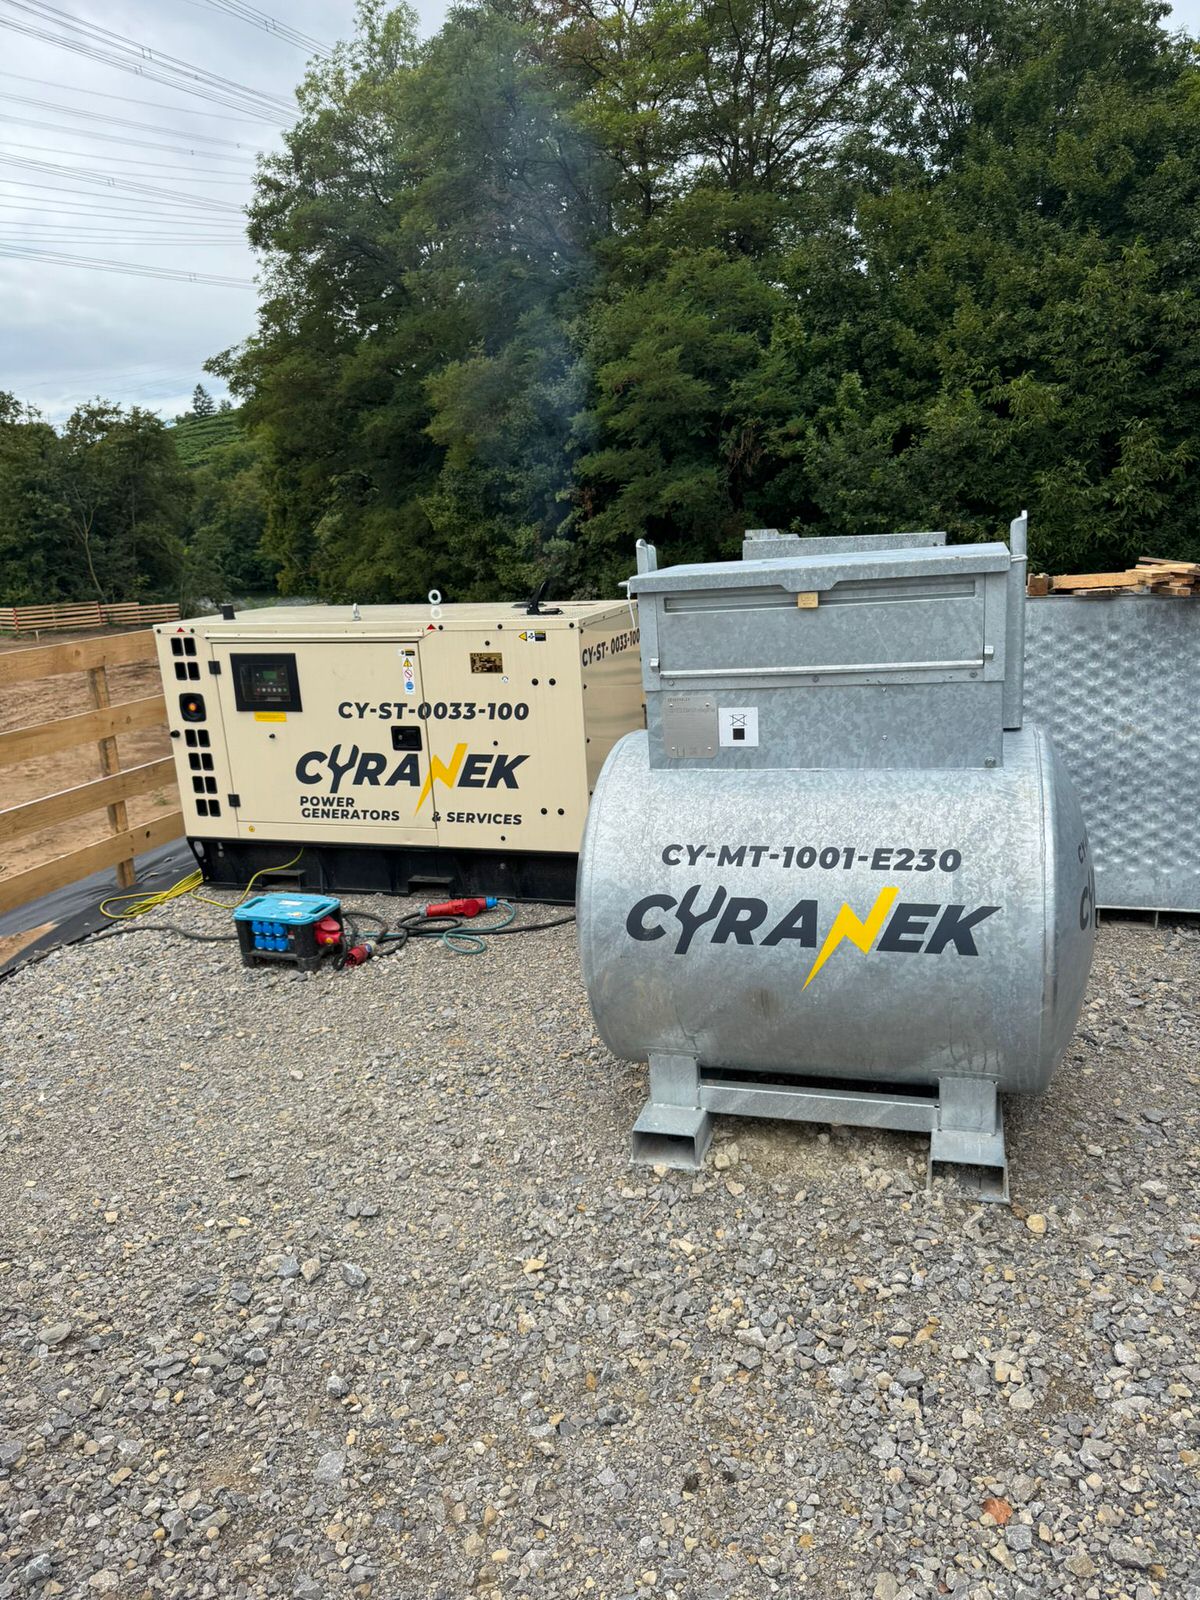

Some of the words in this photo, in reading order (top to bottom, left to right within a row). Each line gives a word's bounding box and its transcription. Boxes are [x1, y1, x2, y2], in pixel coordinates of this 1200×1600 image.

[338, 701, 530, 720] CY-ST-0033-100
[295, 743, 531, 817] CYRANEK
[300, 796, 355, 808] POWER
[301, 808, 400, 821] GENERATORS
[432, 811, 442, 822] &
[446, 812, 523, 825] SERVICES
[661, 844, 962, 873] CY-MT-1001-E230
[625, 884, 1002, 992] CYRANEK
